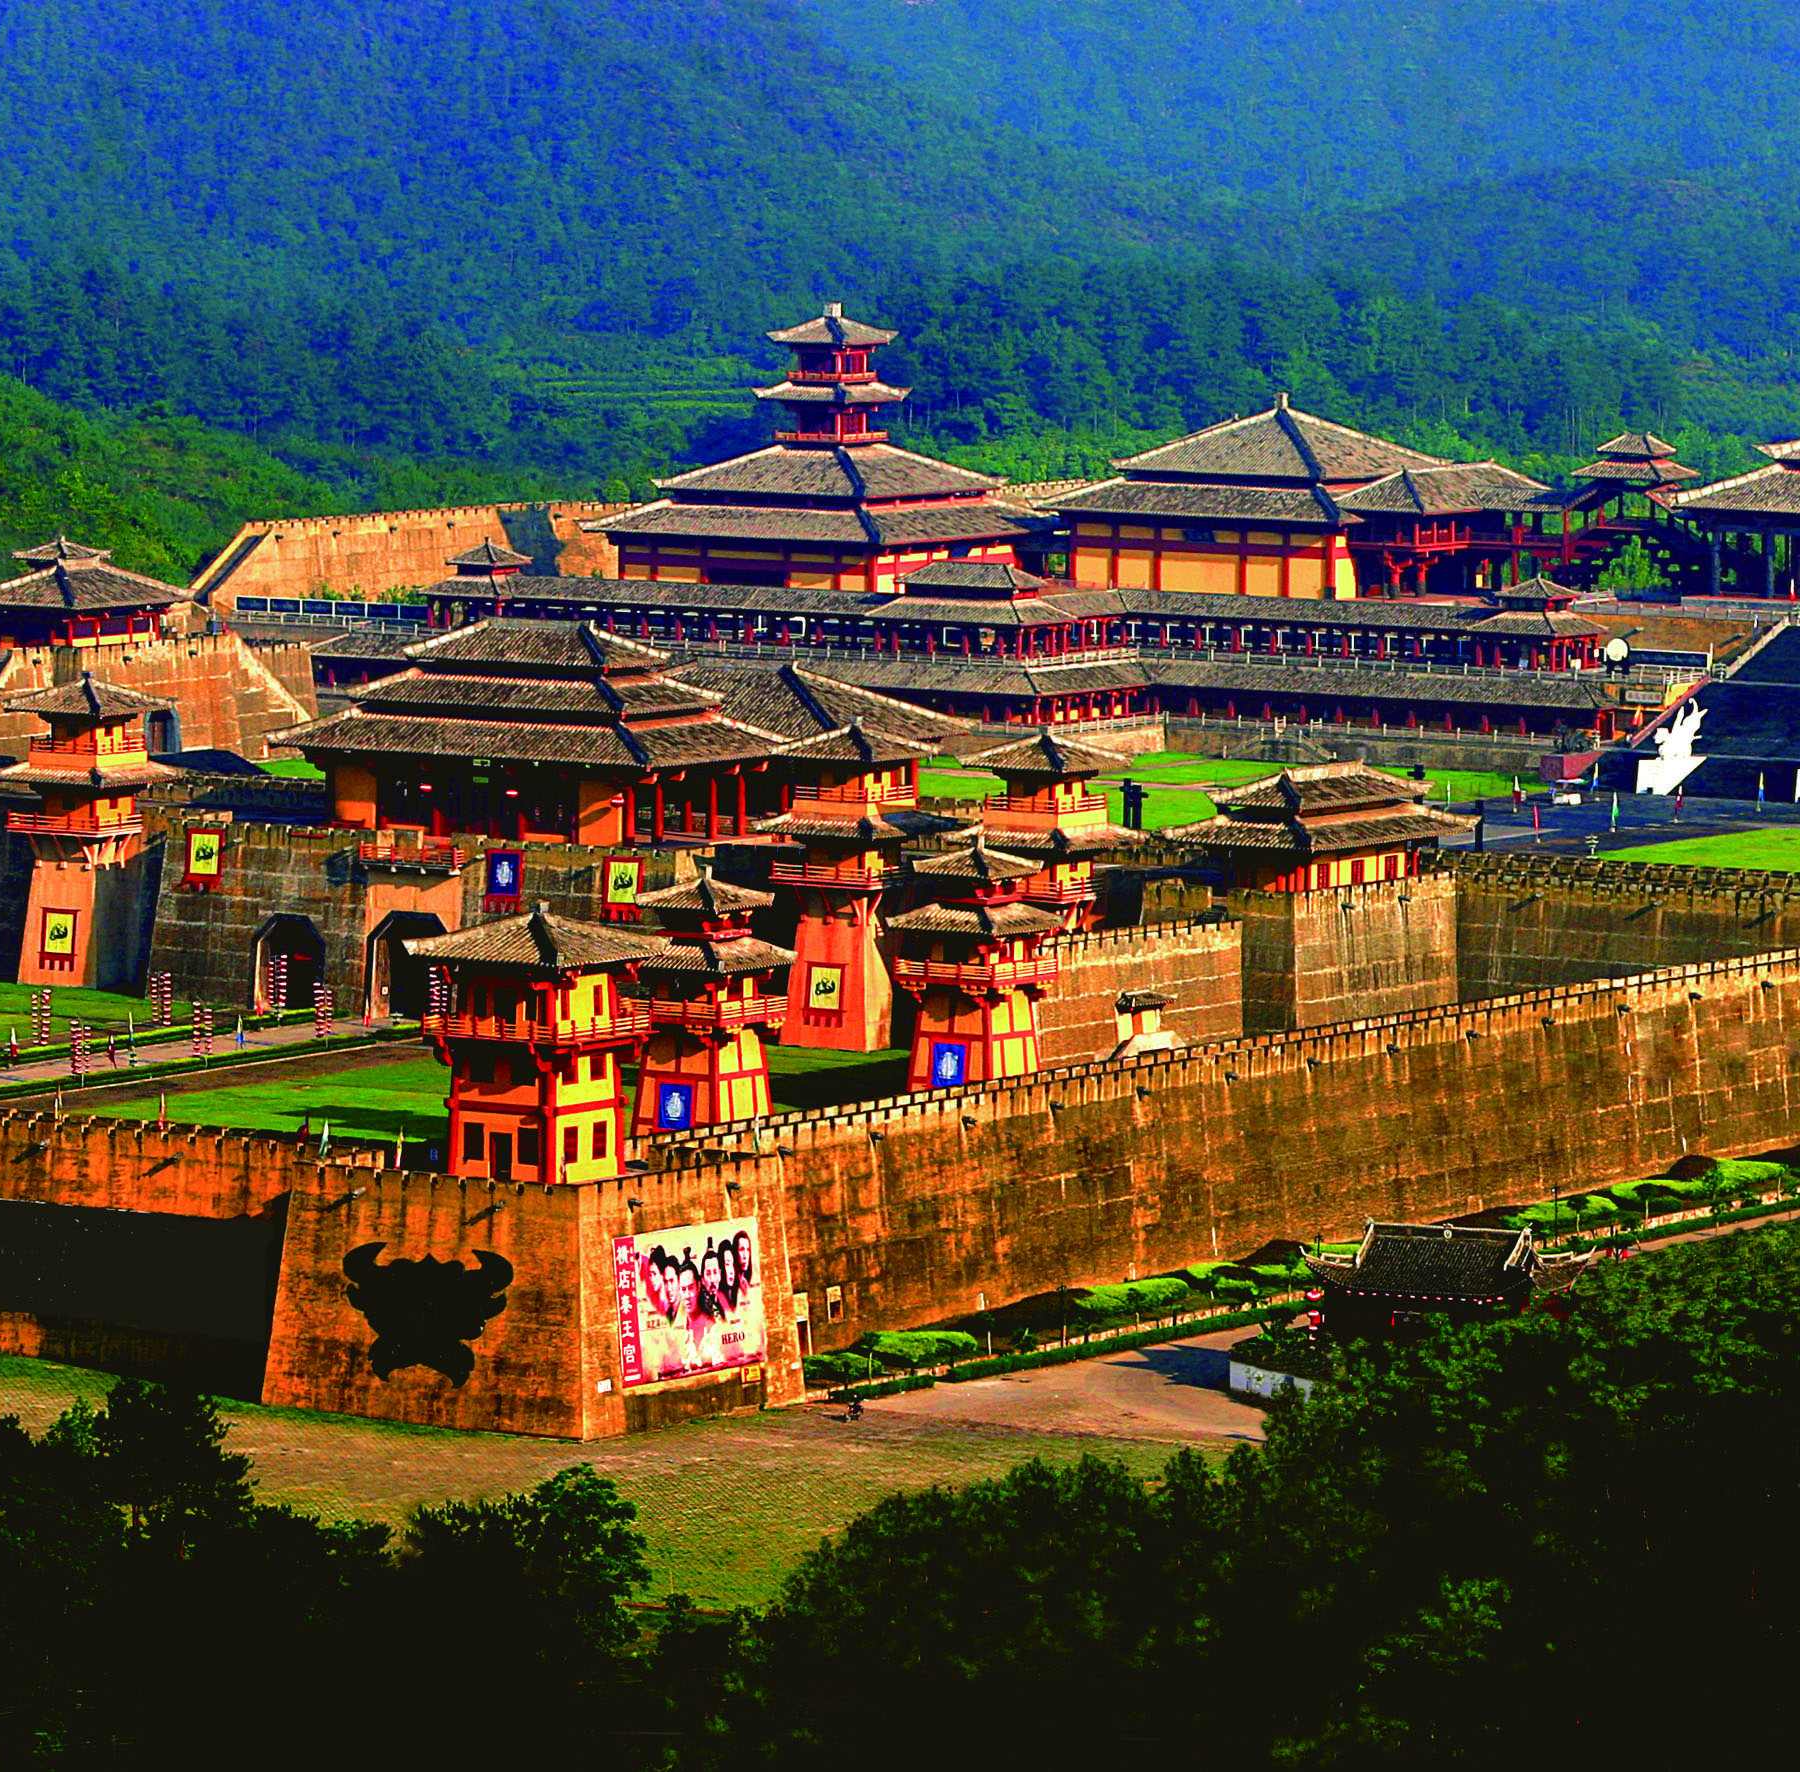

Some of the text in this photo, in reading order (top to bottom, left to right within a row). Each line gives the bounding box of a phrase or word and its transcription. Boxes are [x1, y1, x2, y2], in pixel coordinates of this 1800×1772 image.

[616, 1244, 636, 1364] 横店秦王宫
[721, 1330, 745, 1345] HERO
